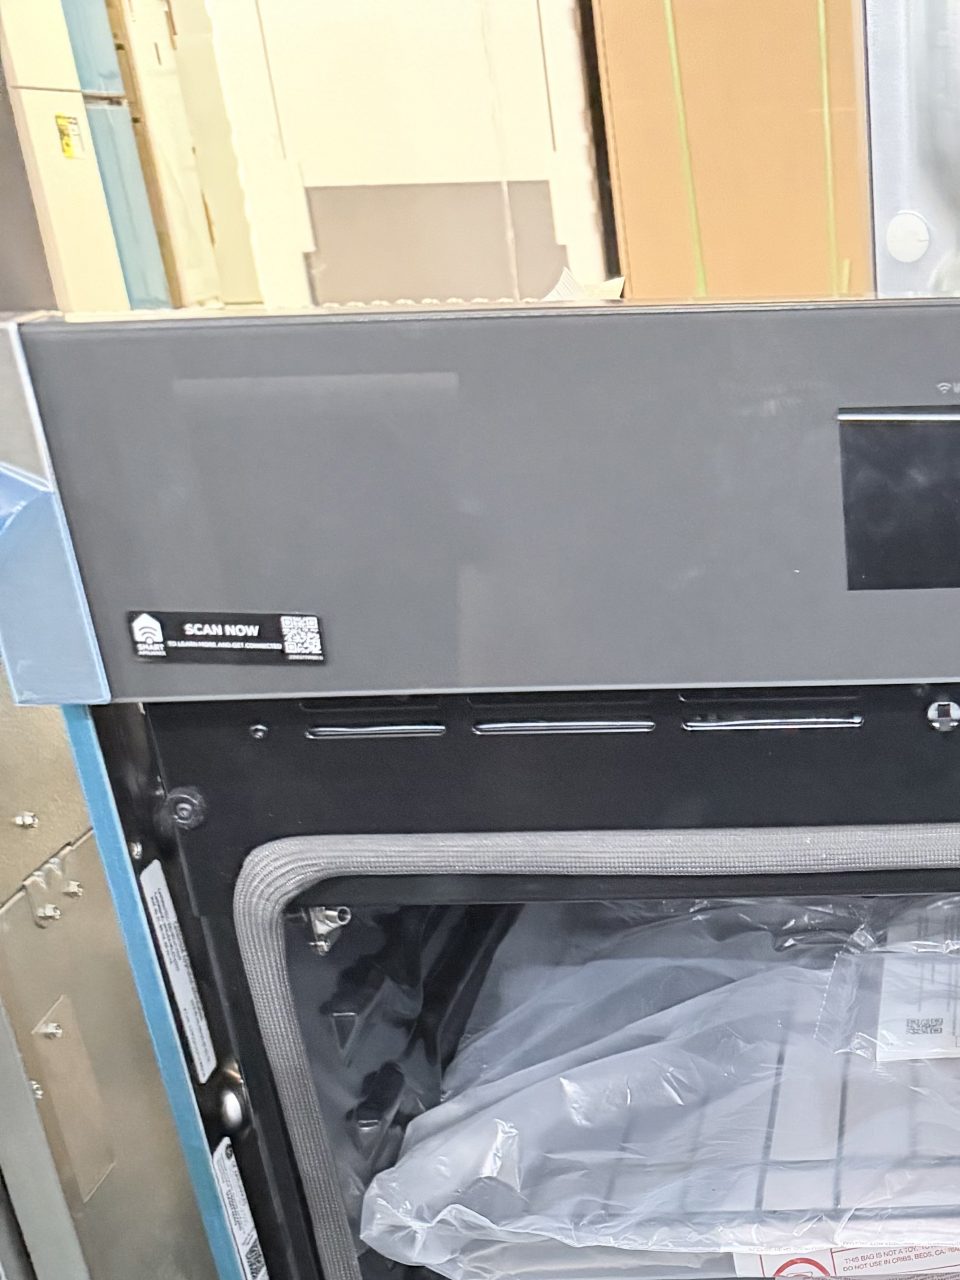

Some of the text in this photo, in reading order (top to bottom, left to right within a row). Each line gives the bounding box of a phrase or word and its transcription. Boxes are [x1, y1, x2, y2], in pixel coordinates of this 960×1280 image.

[184, 623, 260, 637] SCAN NOW
[844, 1256, 860, 1264] THIS
[860, 1254, 875, 1262] BAG
[870, 1260, 882, 1268] USE
